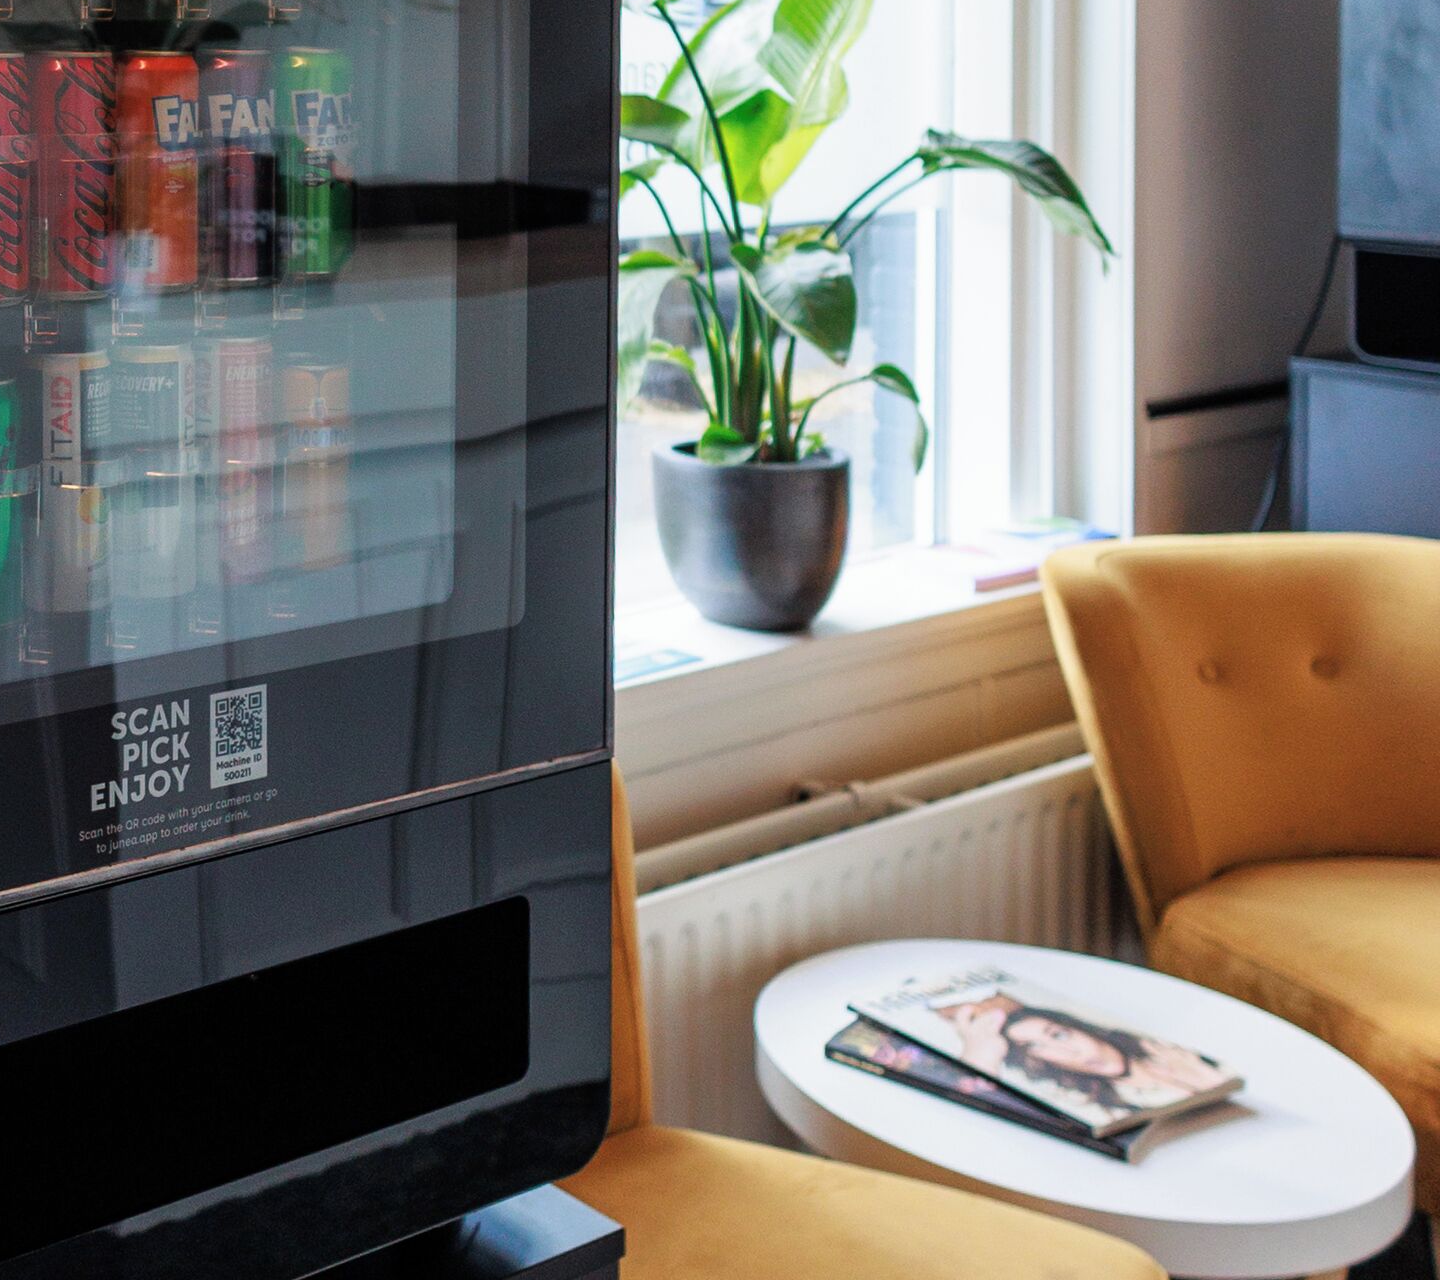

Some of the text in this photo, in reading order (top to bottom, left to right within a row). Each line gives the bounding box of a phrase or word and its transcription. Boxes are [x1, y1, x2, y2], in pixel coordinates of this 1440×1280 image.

[50, 375, 73, 488] FITAID
[111, 698, 190, 740] SCAN
[122, 731, 190, 772] PICK
[216, 752, 263, 771] Machine ID
[90, 764, 190, 812] ENJOY
[79, 788, 278, 841] Scan the QR code with your camera or go
[96, 844, 107, 854] to
[109, 831, 158, 854] junea.app
[160, 829, 171, 838] to
[173, 821, 198, 835] order
[200, 816, 222, 832] your
